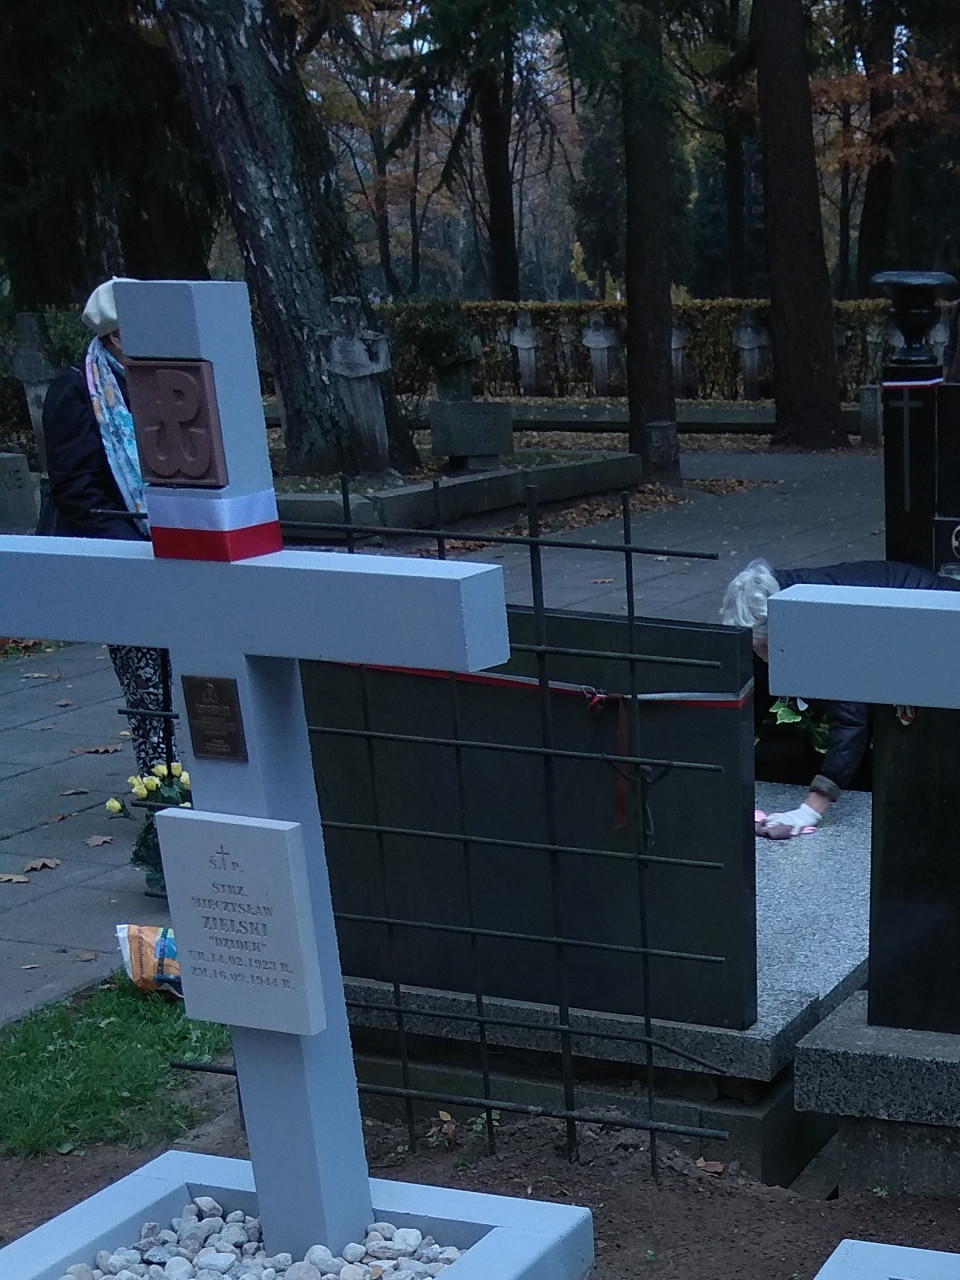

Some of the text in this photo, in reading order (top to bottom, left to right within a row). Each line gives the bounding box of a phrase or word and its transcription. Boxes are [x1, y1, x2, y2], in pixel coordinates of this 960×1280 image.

[209, 854, 245, 873] Ś. P.
[211, 882, 249, 897] STRZ.
[191, 896, 273, 917] MIECZYSŁAW
[201, 915, 269, 938] ZIELSKI
